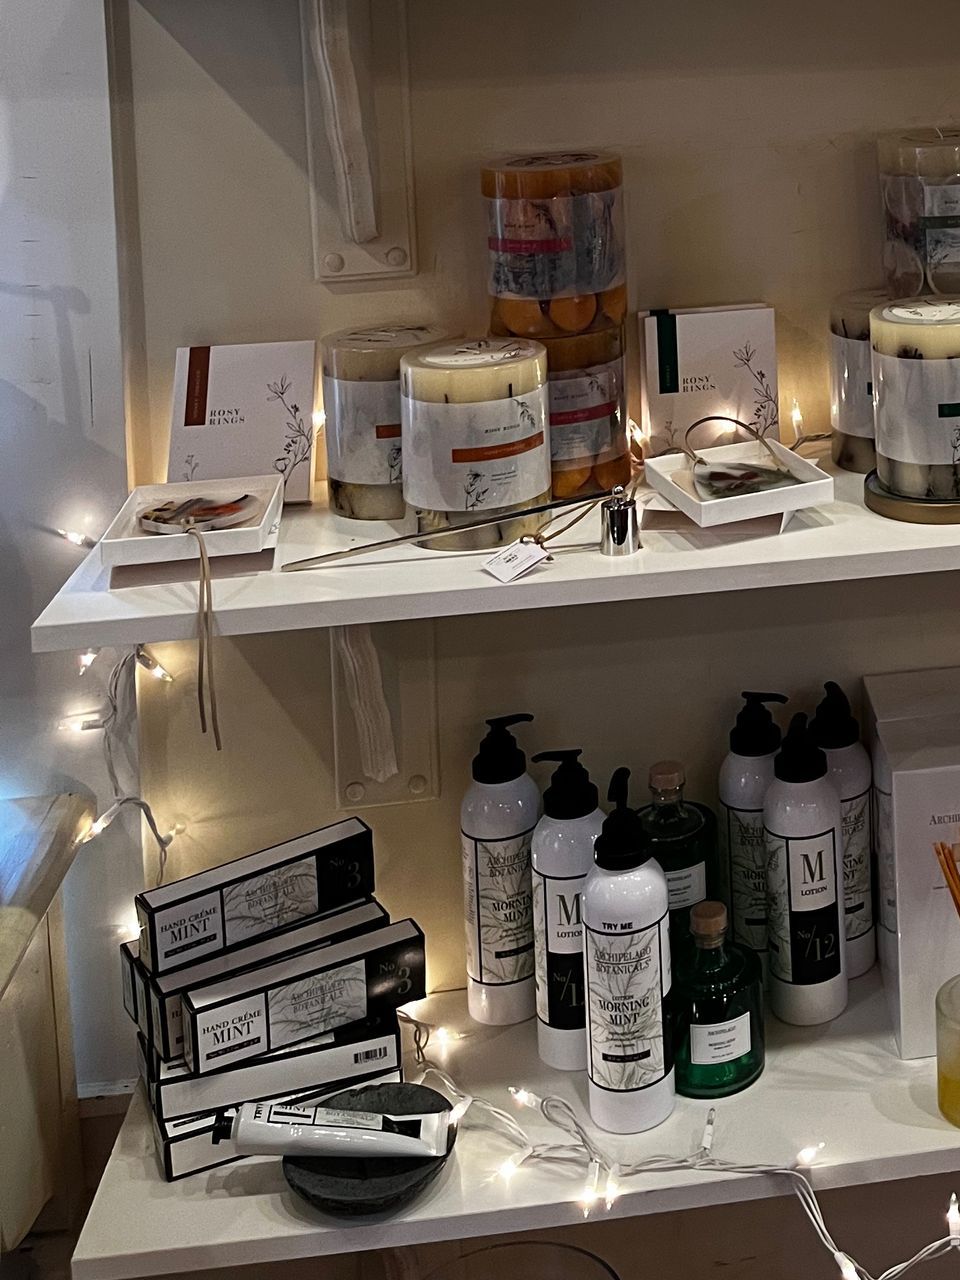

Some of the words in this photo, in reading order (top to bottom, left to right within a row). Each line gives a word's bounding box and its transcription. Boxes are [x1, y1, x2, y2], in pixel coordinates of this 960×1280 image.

[682, 375, 711, 385] ROSY
[682, 384, 716, 394] RINGS
[209, 408, 241, 417] ROSY
[209, 416, 245, 426] RINGS
[800, 849, 827, 885] M
[347, 862, 362, 888] 3
[800, 885, 828, 897] LOTION
[503, 907, 529, 923] MINT
[556, 891, 583, 926] M
[160, 918, 187, 933] HAND
[170, 917, 210, 945] MINT
[602, 922, 618, 931] TRY
[620, 921, 633, 930] ME
[593, 946, 652, 965] ARCHIPELAGO
[397, 966, 413, 995] 3
[598, 996, 650, 1014] MORNING
[608, 1012, 640, 1027] MINT
[202, 1021, 229, 1035] HAND
[213, 1020, 254, 1046] MINT
